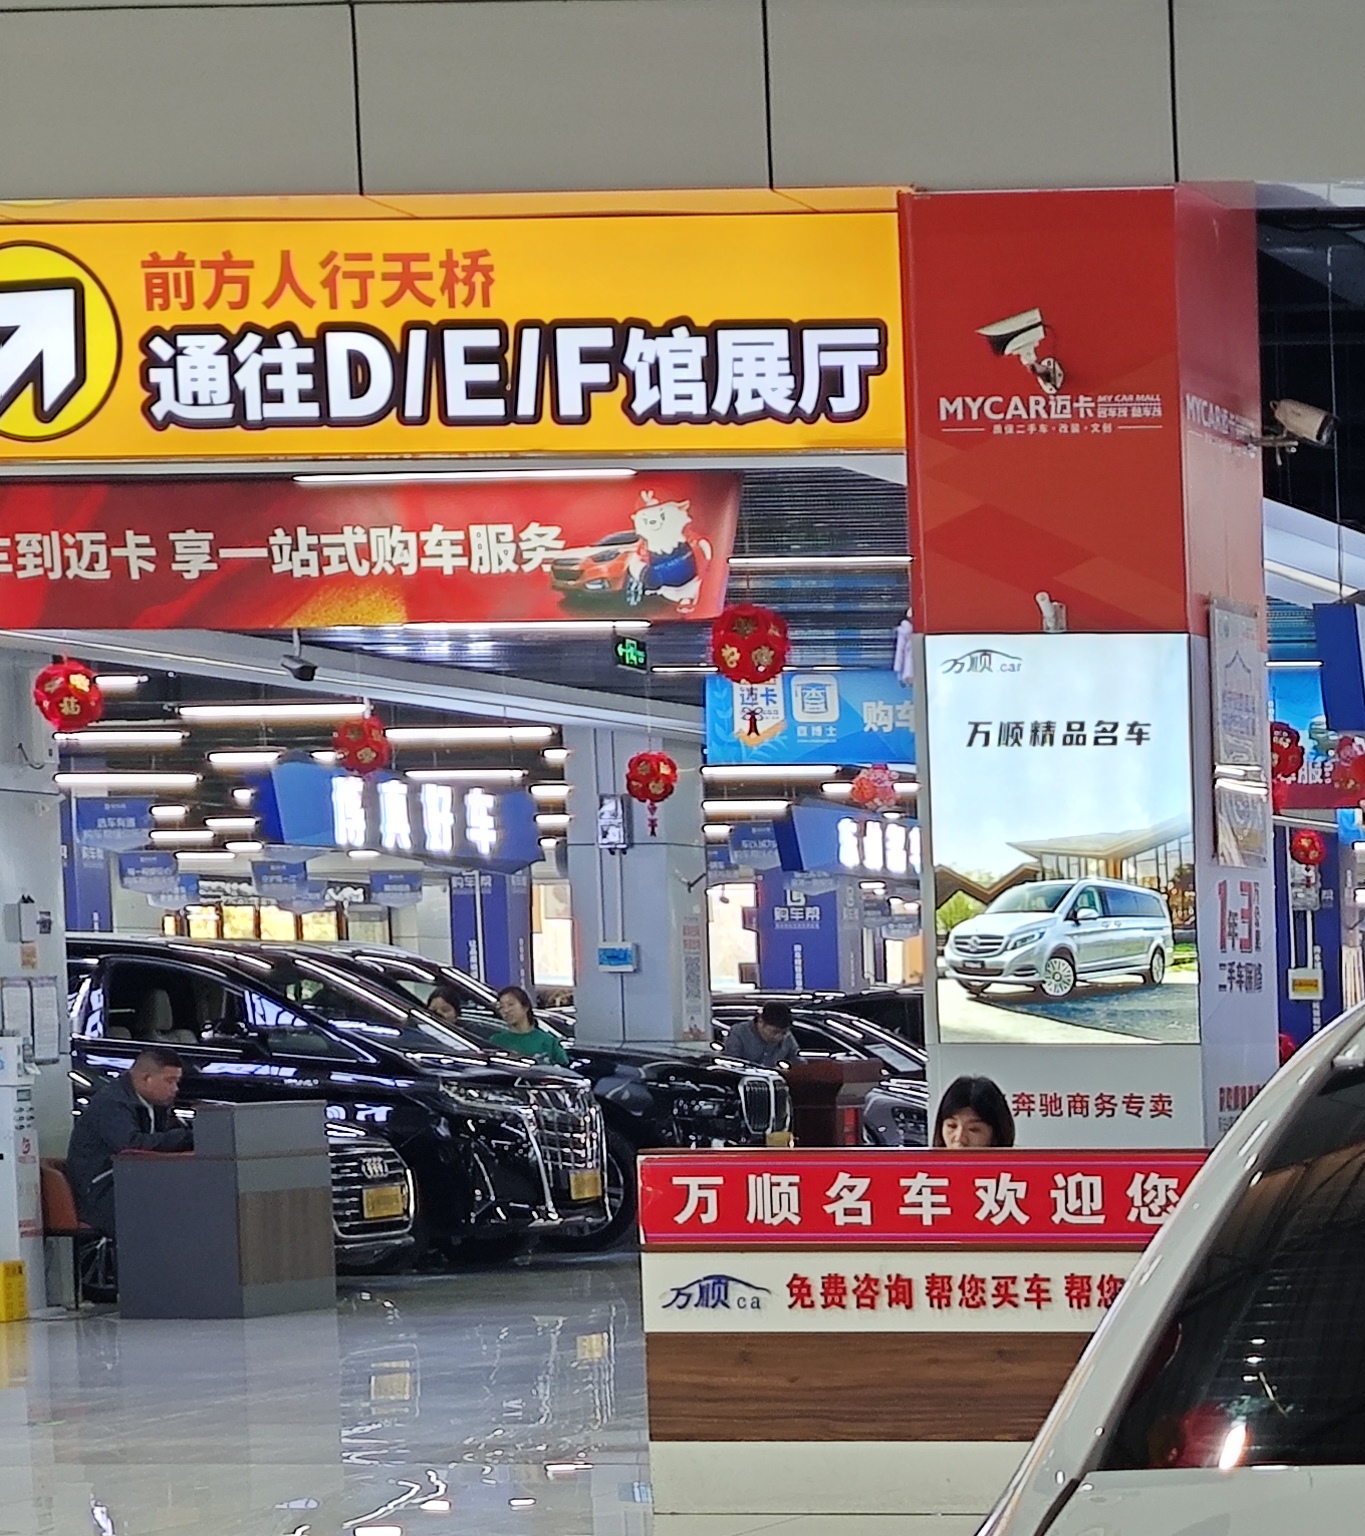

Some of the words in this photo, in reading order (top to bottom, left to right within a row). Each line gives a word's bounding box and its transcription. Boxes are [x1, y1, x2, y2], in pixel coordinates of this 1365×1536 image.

[140, 248, 496, 312] 前方人行天桥
[147, 324, 884, 426] 通往D/E/F馆展厅
[939, 394, 1096, 421] MYCAR迈卡
[0, 530, 157, 581] 到迈卡
[168, 521, 568, 581] 享一站式购车服务
[966, 718, 1153, 748] 万顺精品名车
[1012, 1092, 1174, 1119] 奔驰商务专卖
[671, 1171, 1182, 1227] 万顺名车欢迎您
[785, 1272, 914, 1310] 免费咨询
[924, 1272, 1052, 1310] 帮您买车
